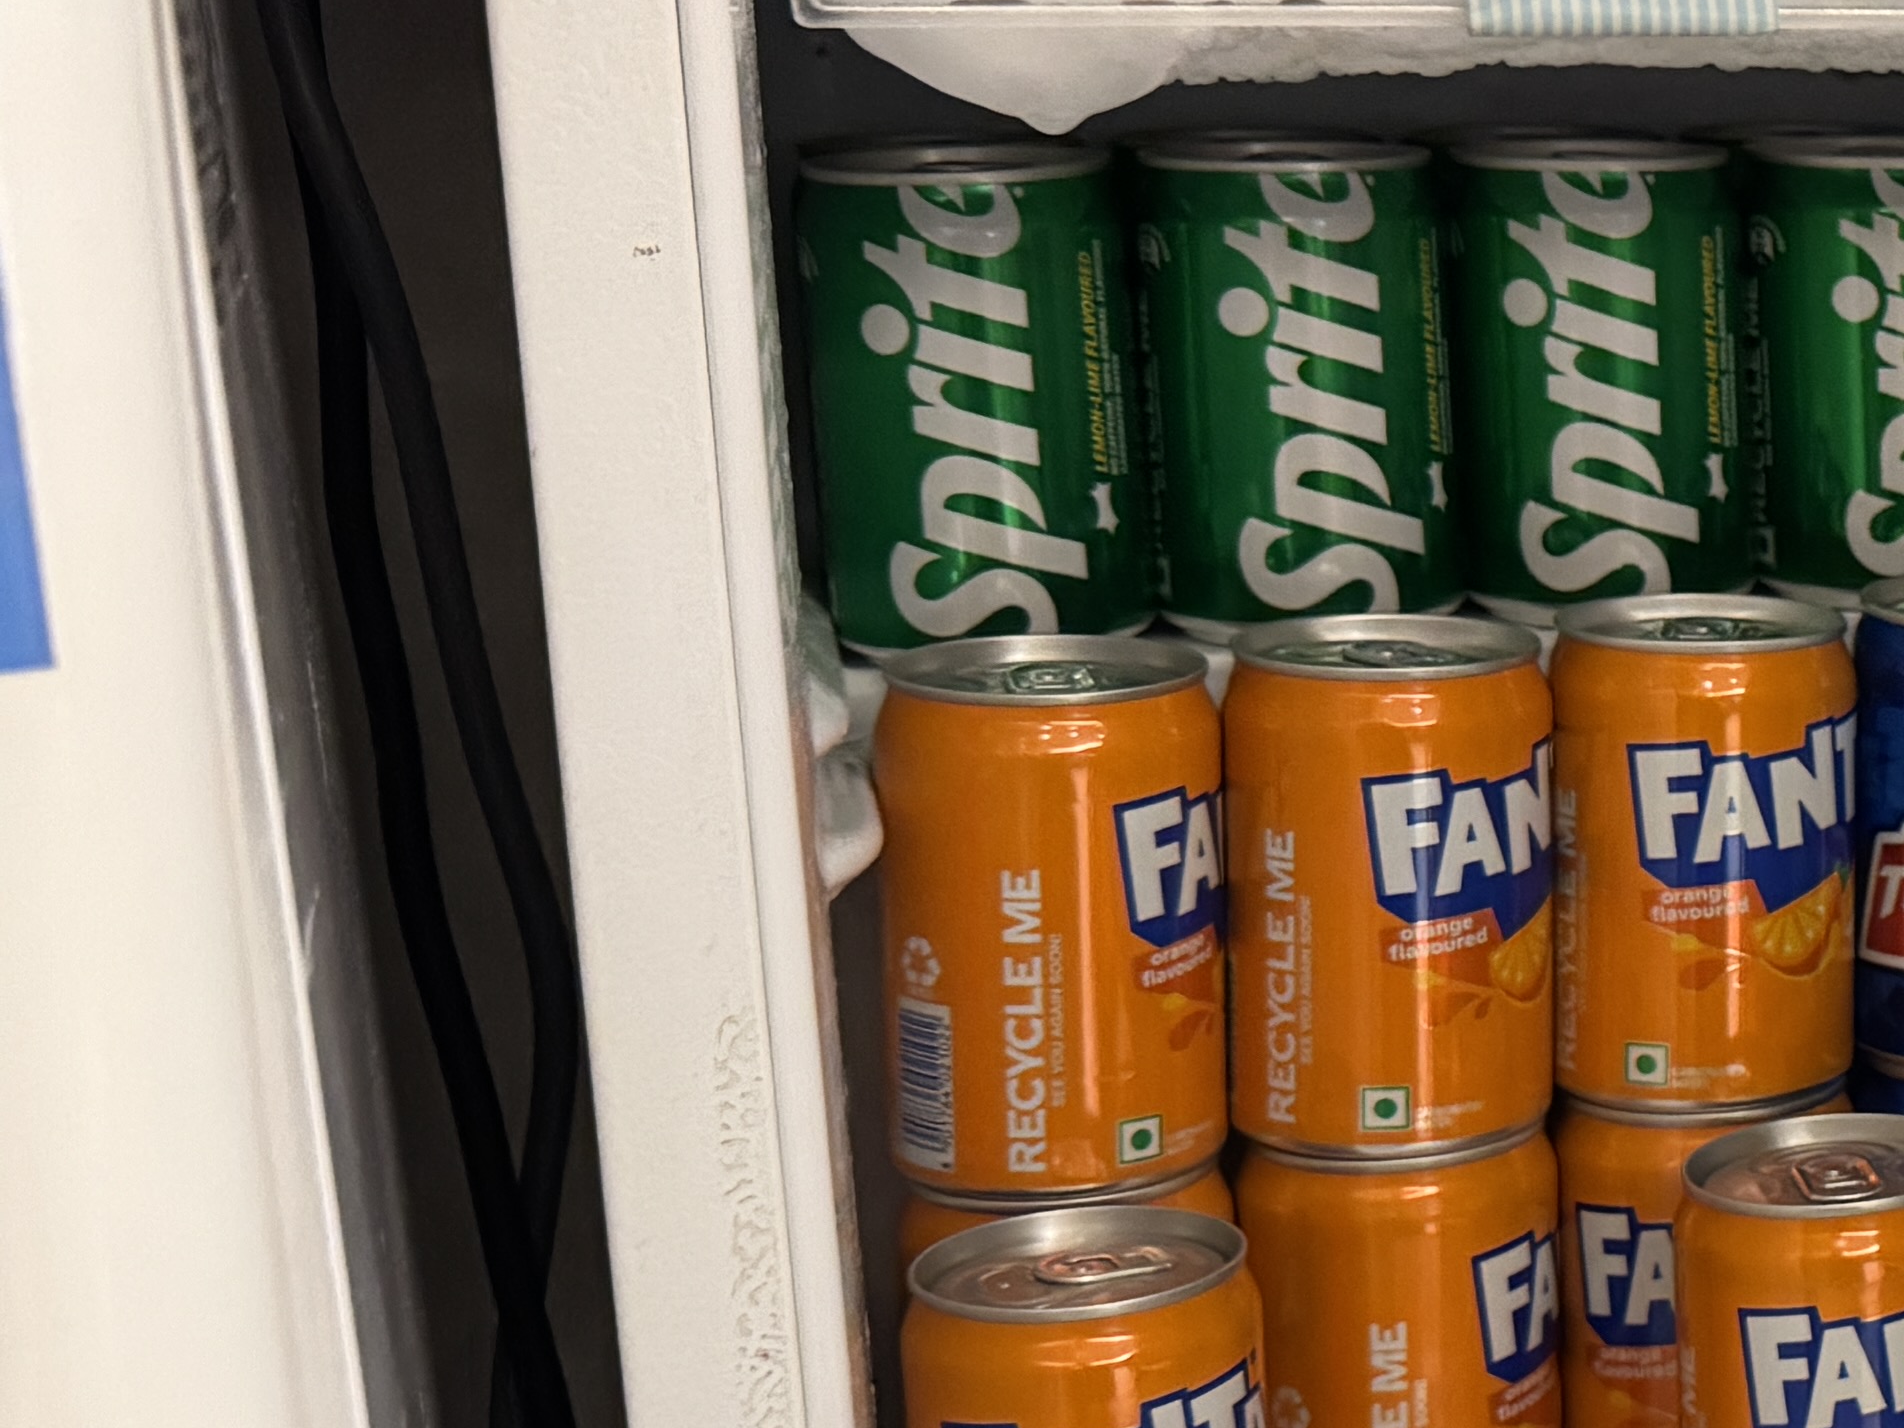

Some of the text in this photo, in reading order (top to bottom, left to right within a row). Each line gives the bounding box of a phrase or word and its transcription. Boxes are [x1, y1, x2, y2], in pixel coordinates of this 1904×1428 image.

[861, 182, 1088, 638] Sprite
[1078, 251, 1108, 473] LEMON-LIME FLAVOURED
[1218, 172, 1426, 615] Sprite
[1503, 170, 1699, 594] Sprite
[1123, 792, 1224, 922] FA
[1371, 742, 1553, 897] FAN
[1264, 828, 1296, 1124] RECYCLE ME
[1388, 927, 1489, 962] flavoured
[1400, 917, 1474, 941] orange
[1001, 870, 1048, 1172] RECYCLE ME
[1480, 1232, 1559, 1363] FA
[1579, 1211, 1676, 1327] FA
[1369, 1321, 1409, 1393] ME
